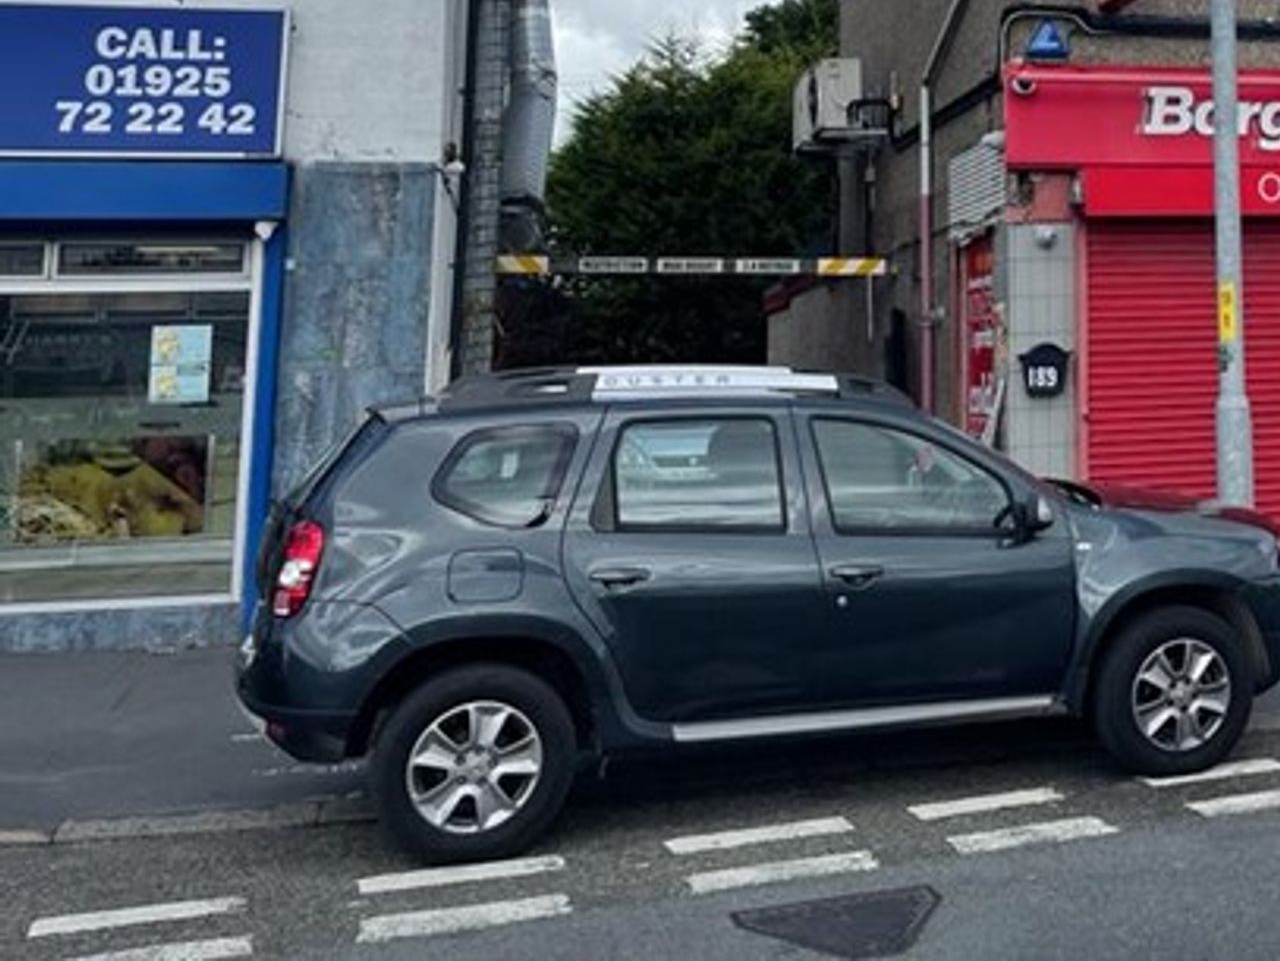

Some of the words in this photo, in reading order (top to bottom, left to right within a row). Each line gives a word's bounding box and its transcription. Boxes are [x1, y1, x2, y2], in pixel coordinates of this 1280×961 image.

[95, 25, 227, 61] CALL:
[84, 63, 232, 98] 01925
[55, 100, 113, 134] 72
[125, 101, 185, 135] 22
[197, 102, 257, 135] 42
